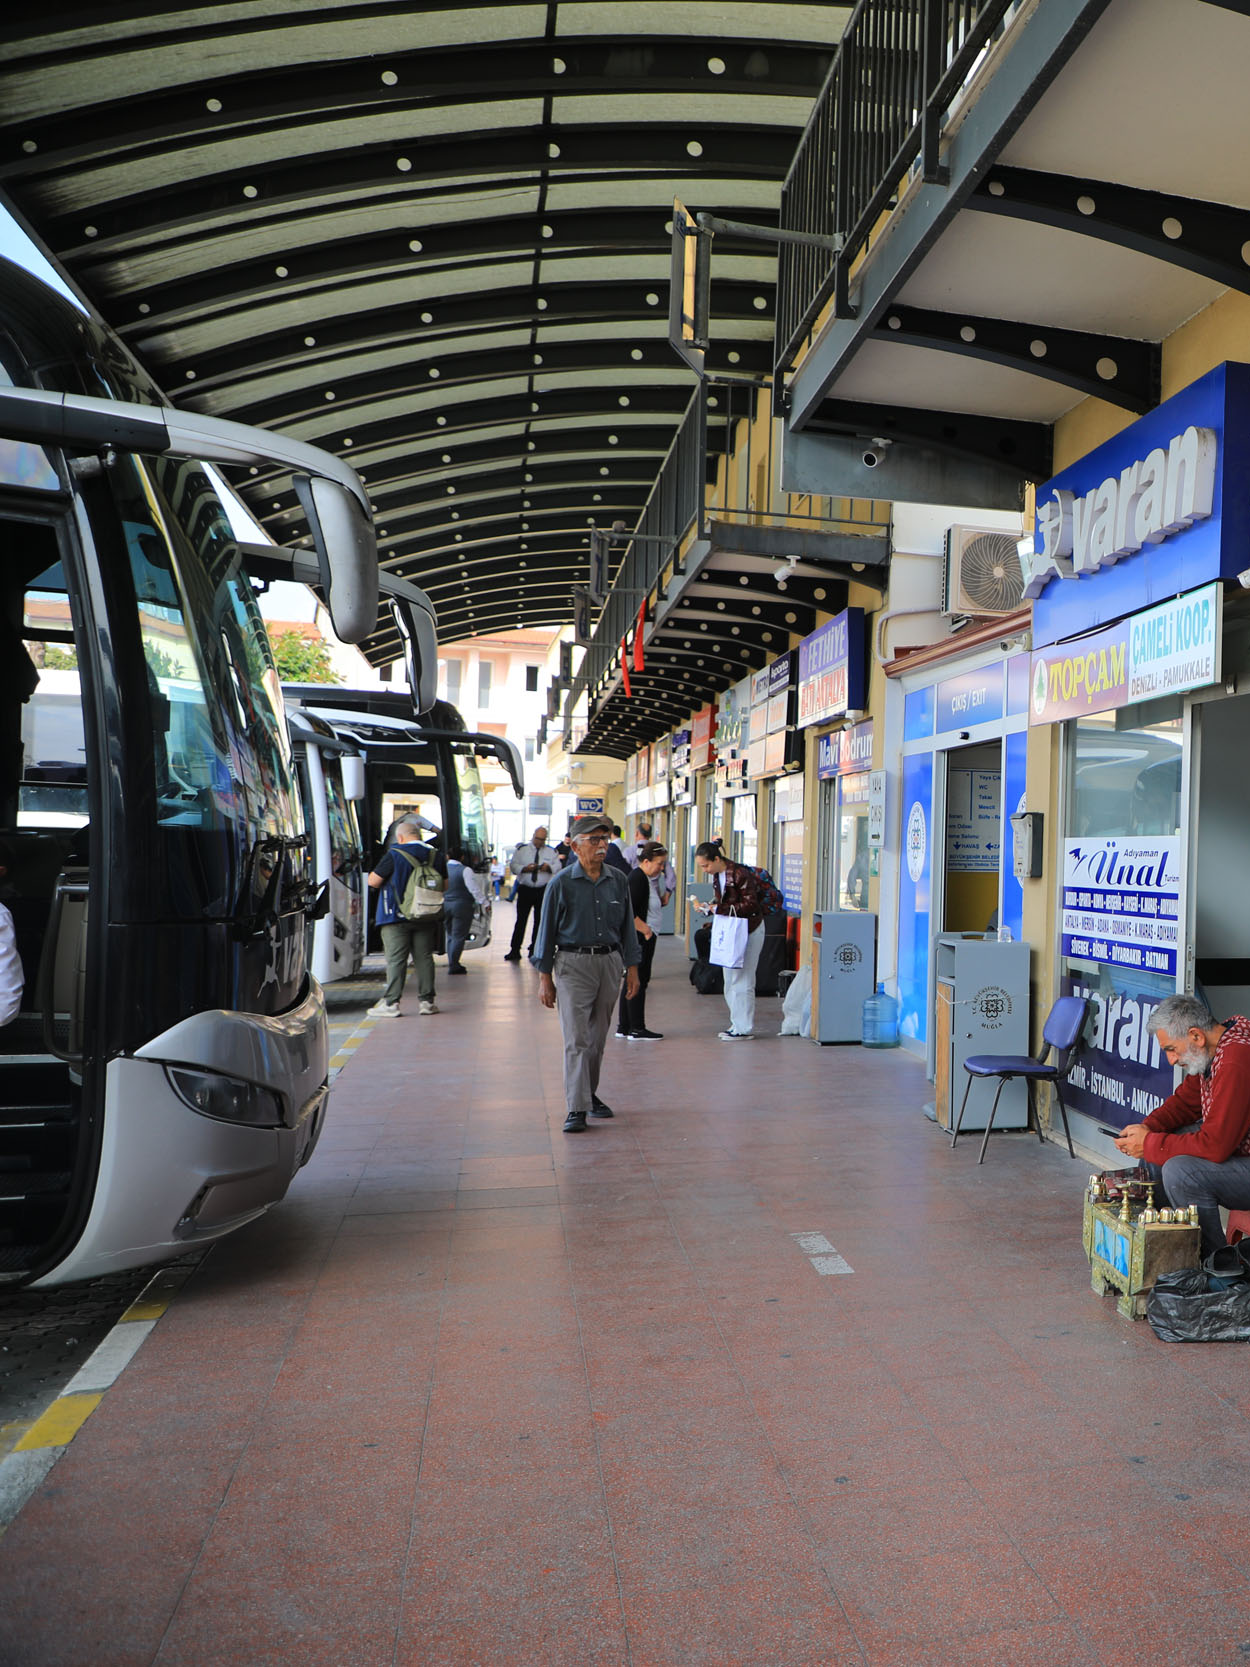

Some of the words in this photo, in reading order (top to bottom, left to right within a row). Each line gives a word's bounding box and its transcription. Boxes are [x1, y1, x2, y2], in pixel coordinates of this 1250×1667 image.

[1072, 425, 1216, 574] varan
[1175, 599, 1212, 653] KOOP.
[1048, 641, 1127, 704] TOPÇAM
[1163, 656, 1211, 688] PAMUKKALE
[951, 692, 967, 716] ÇIKIŞ
[972, 687, 987, 706] EXIT
[819, 732, 840, 769] Mavi
[580, 801, 595, 810] WC
[1088, 841, 1169, 888] Ünal
[1123, 849, 1159, 859] Adıyaman
[1065, 914, 1079, 929] ANTALYA
[1081, 914, 1094, 931] MERSİN
[1097, 918, 1109, 933] ADANA
[1112, 918, 1131, 936] OSMANİYE
[1071, 937, 1090, 956] SİVEREK
[1112, 943, 1141, 966] DİYARBAKIR
[1145, 951, 1169, 970] BATMAN
[1073, 985, 1160, 1069] aran
[1090, 1066, 1126, 1107] İSTANBUL
[1131, 1087, 1165, 1117] ANKAR
